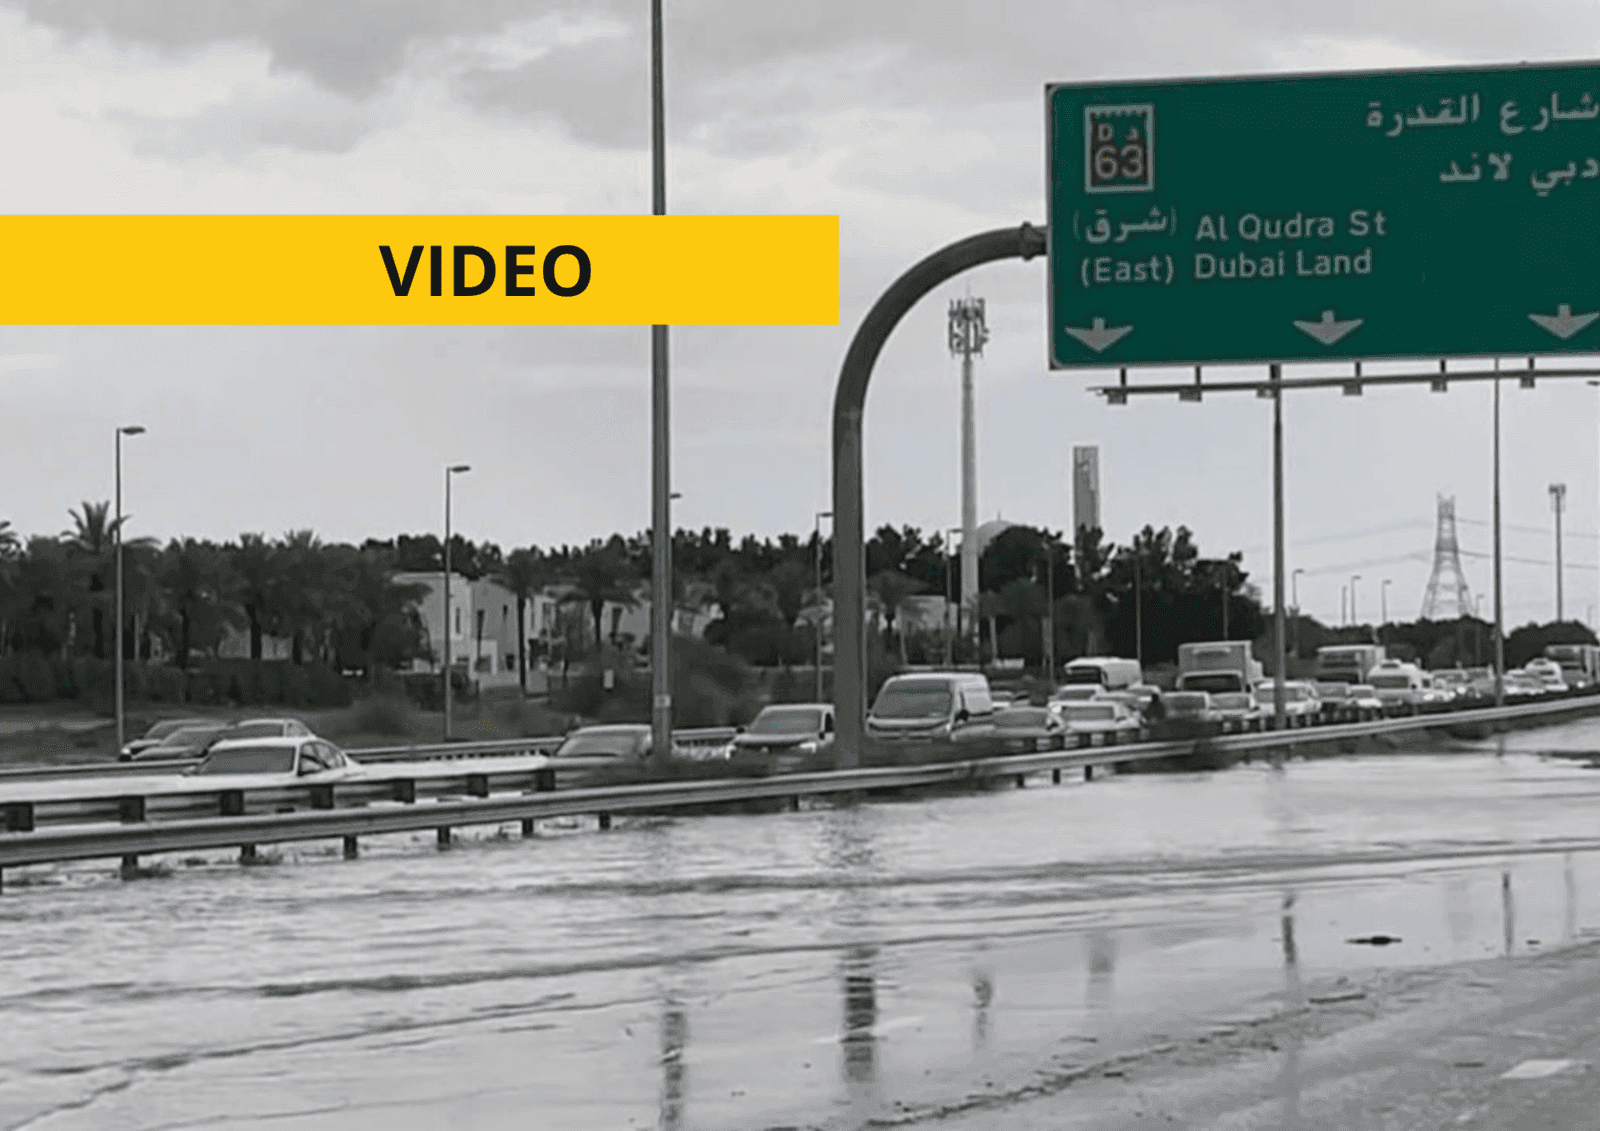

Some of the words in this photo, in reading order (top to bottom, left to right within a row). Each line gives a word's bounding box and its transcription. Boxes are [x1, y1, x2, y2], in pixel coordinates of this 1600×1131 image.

[1367, 93, 1479, 136] القدرة
[1501, 92, 1599, 133] شارع
[1097, 123, 1114, 141] D
[1095, 145, 1144, 179] 63
[1439, 153, 1512, 181] لاند
[1531, 158, 1599, 197] دبي
[1195, 214, 1229, 241] Al
[1238, 211, 1335, 242] Qudra
[1348, 209, 1387, 236] St
[1082, 254, 1174, 288] (East)
[1195, 250, 1285, 279] Dubai
[1297, 247, 1372, 276] Land
